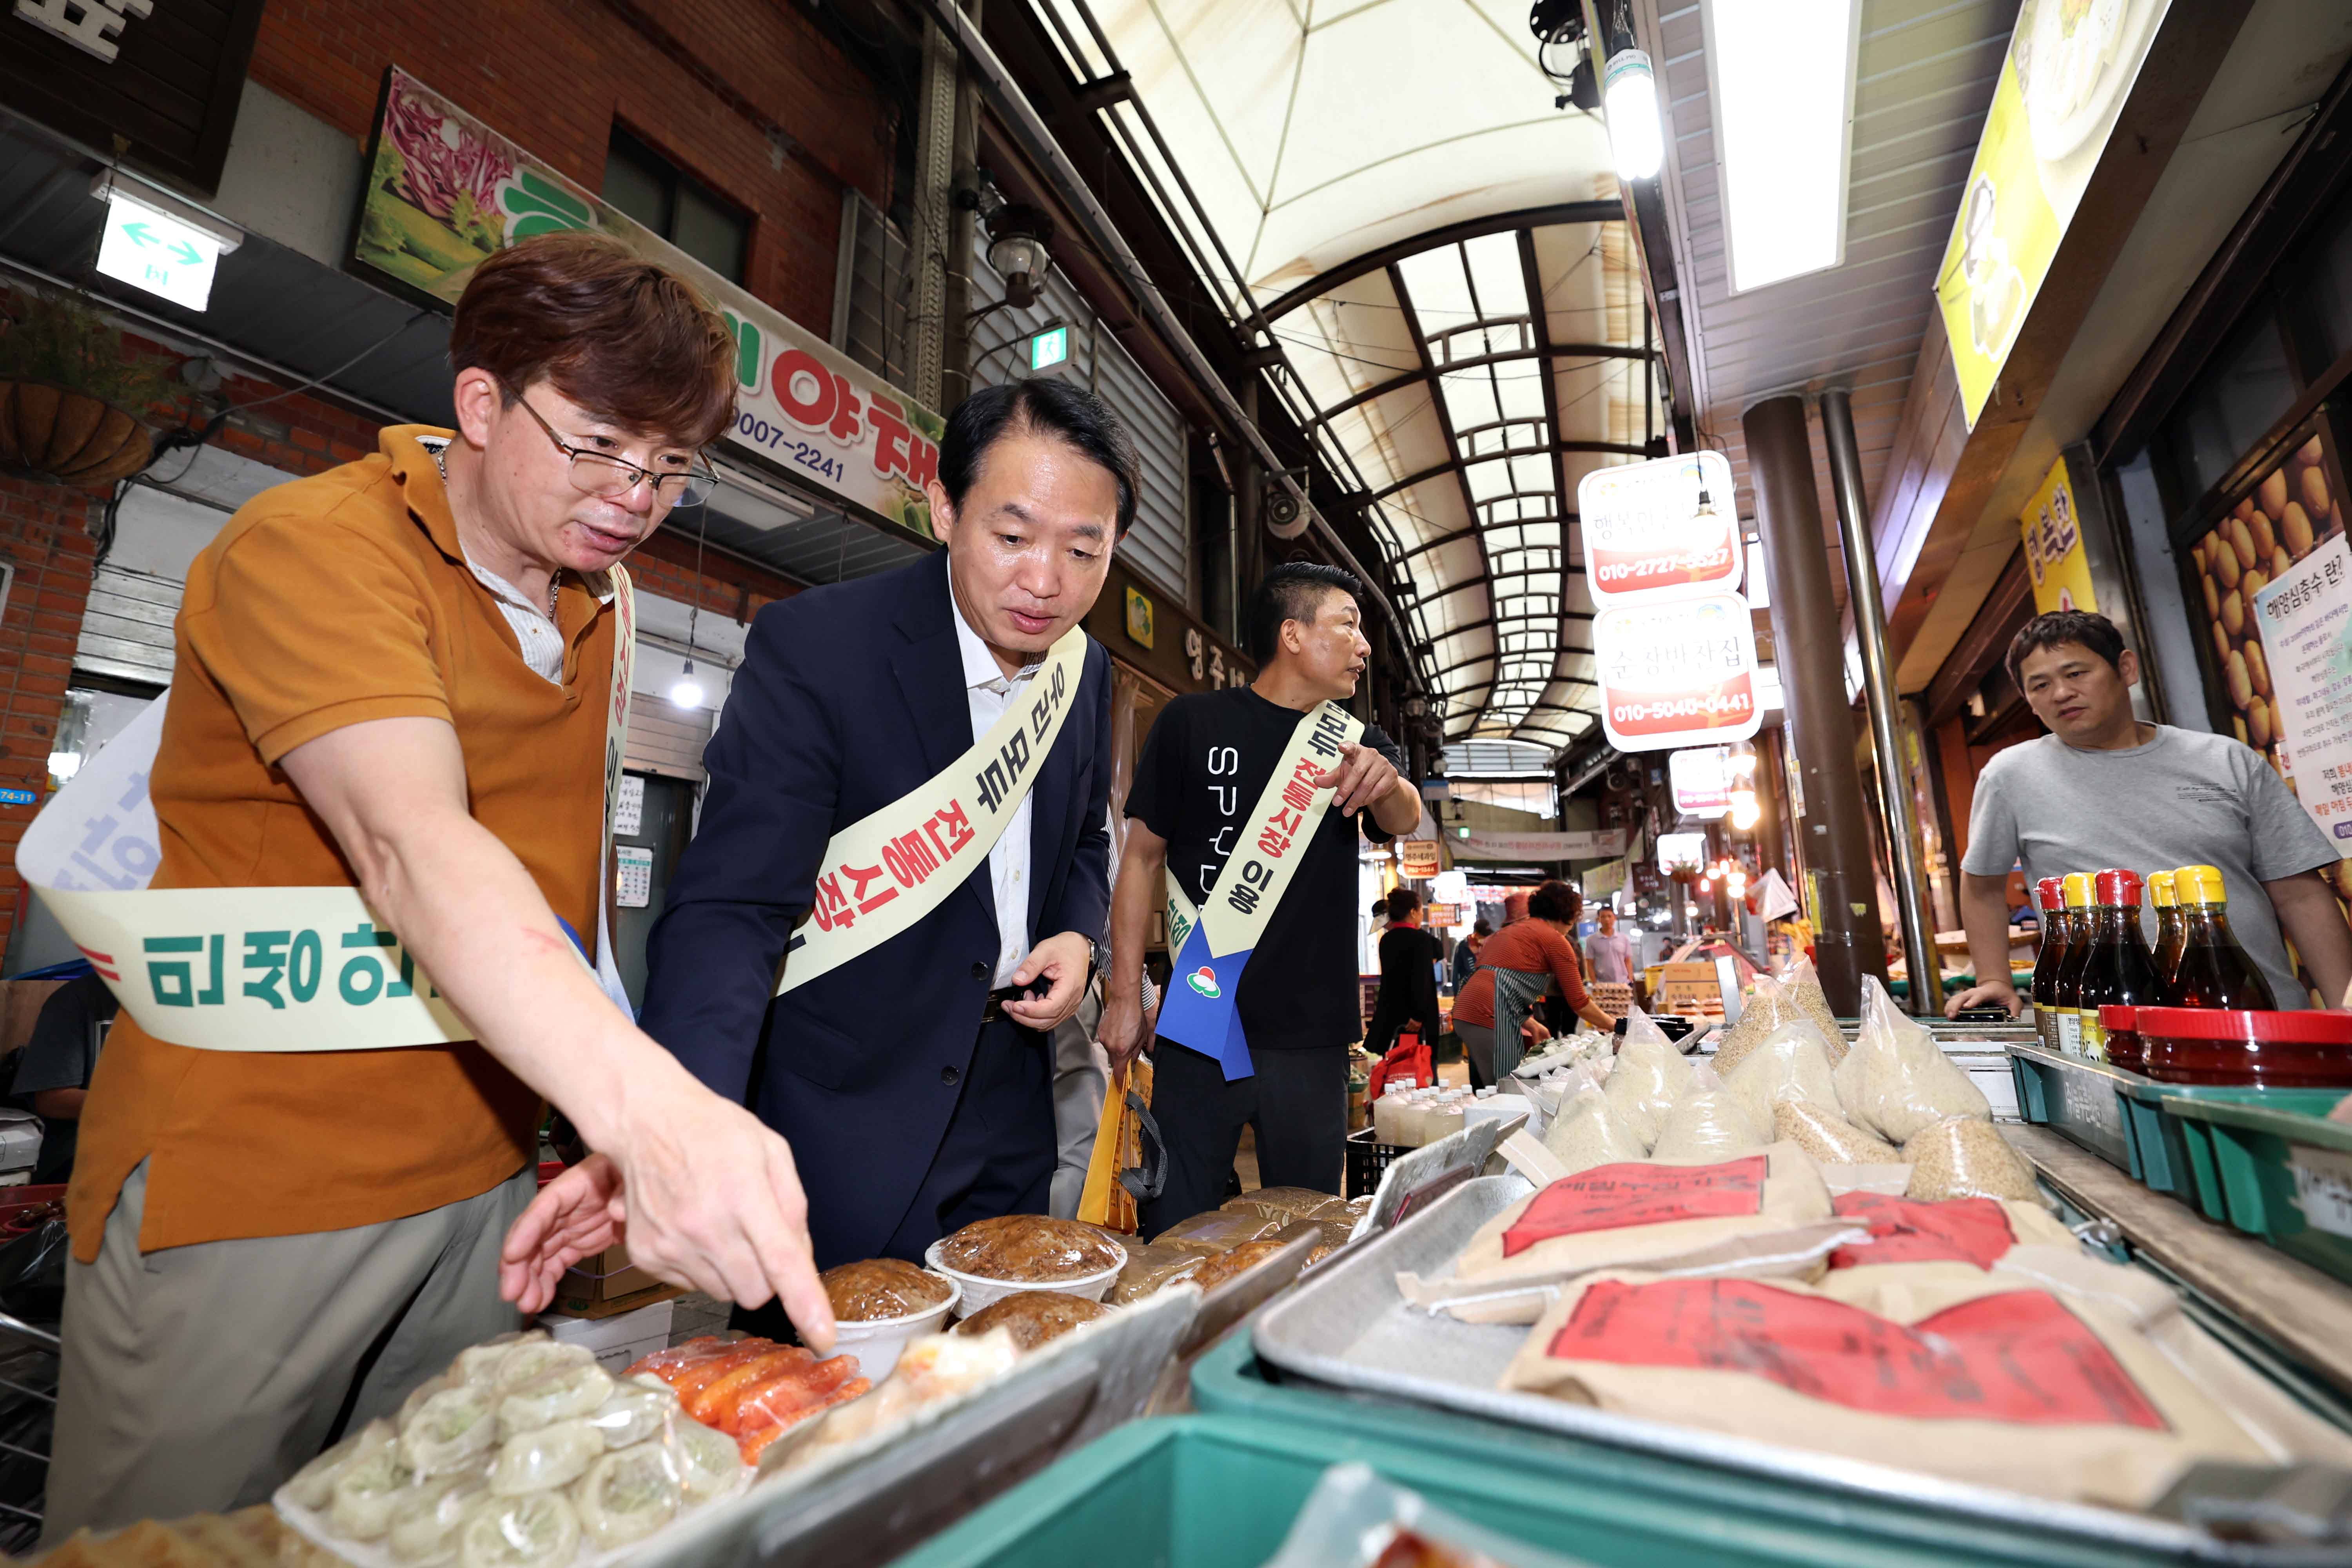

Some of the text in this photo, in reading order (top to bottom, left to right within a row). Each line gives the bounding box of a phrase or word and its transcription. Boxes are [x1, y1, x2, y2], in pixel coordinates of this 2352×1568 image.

[2267, 554, 2343, 619] 해양심층수 란?
[1031, 661, 1065, 746] 우리
[1307, 712, 1348, 758] 모두
[0, 791, 32, 802] 74-11
[977, 726, 1031, 815] 모두
[1258, 757, 1327, 858] 전통시장
[812, 799, 976, 933] 전통시장
[1198, 746, 1239, 913] SPYD
[1228, 860, 1274, 915] 이용
[143, 923, 427, 1009] 민생안
